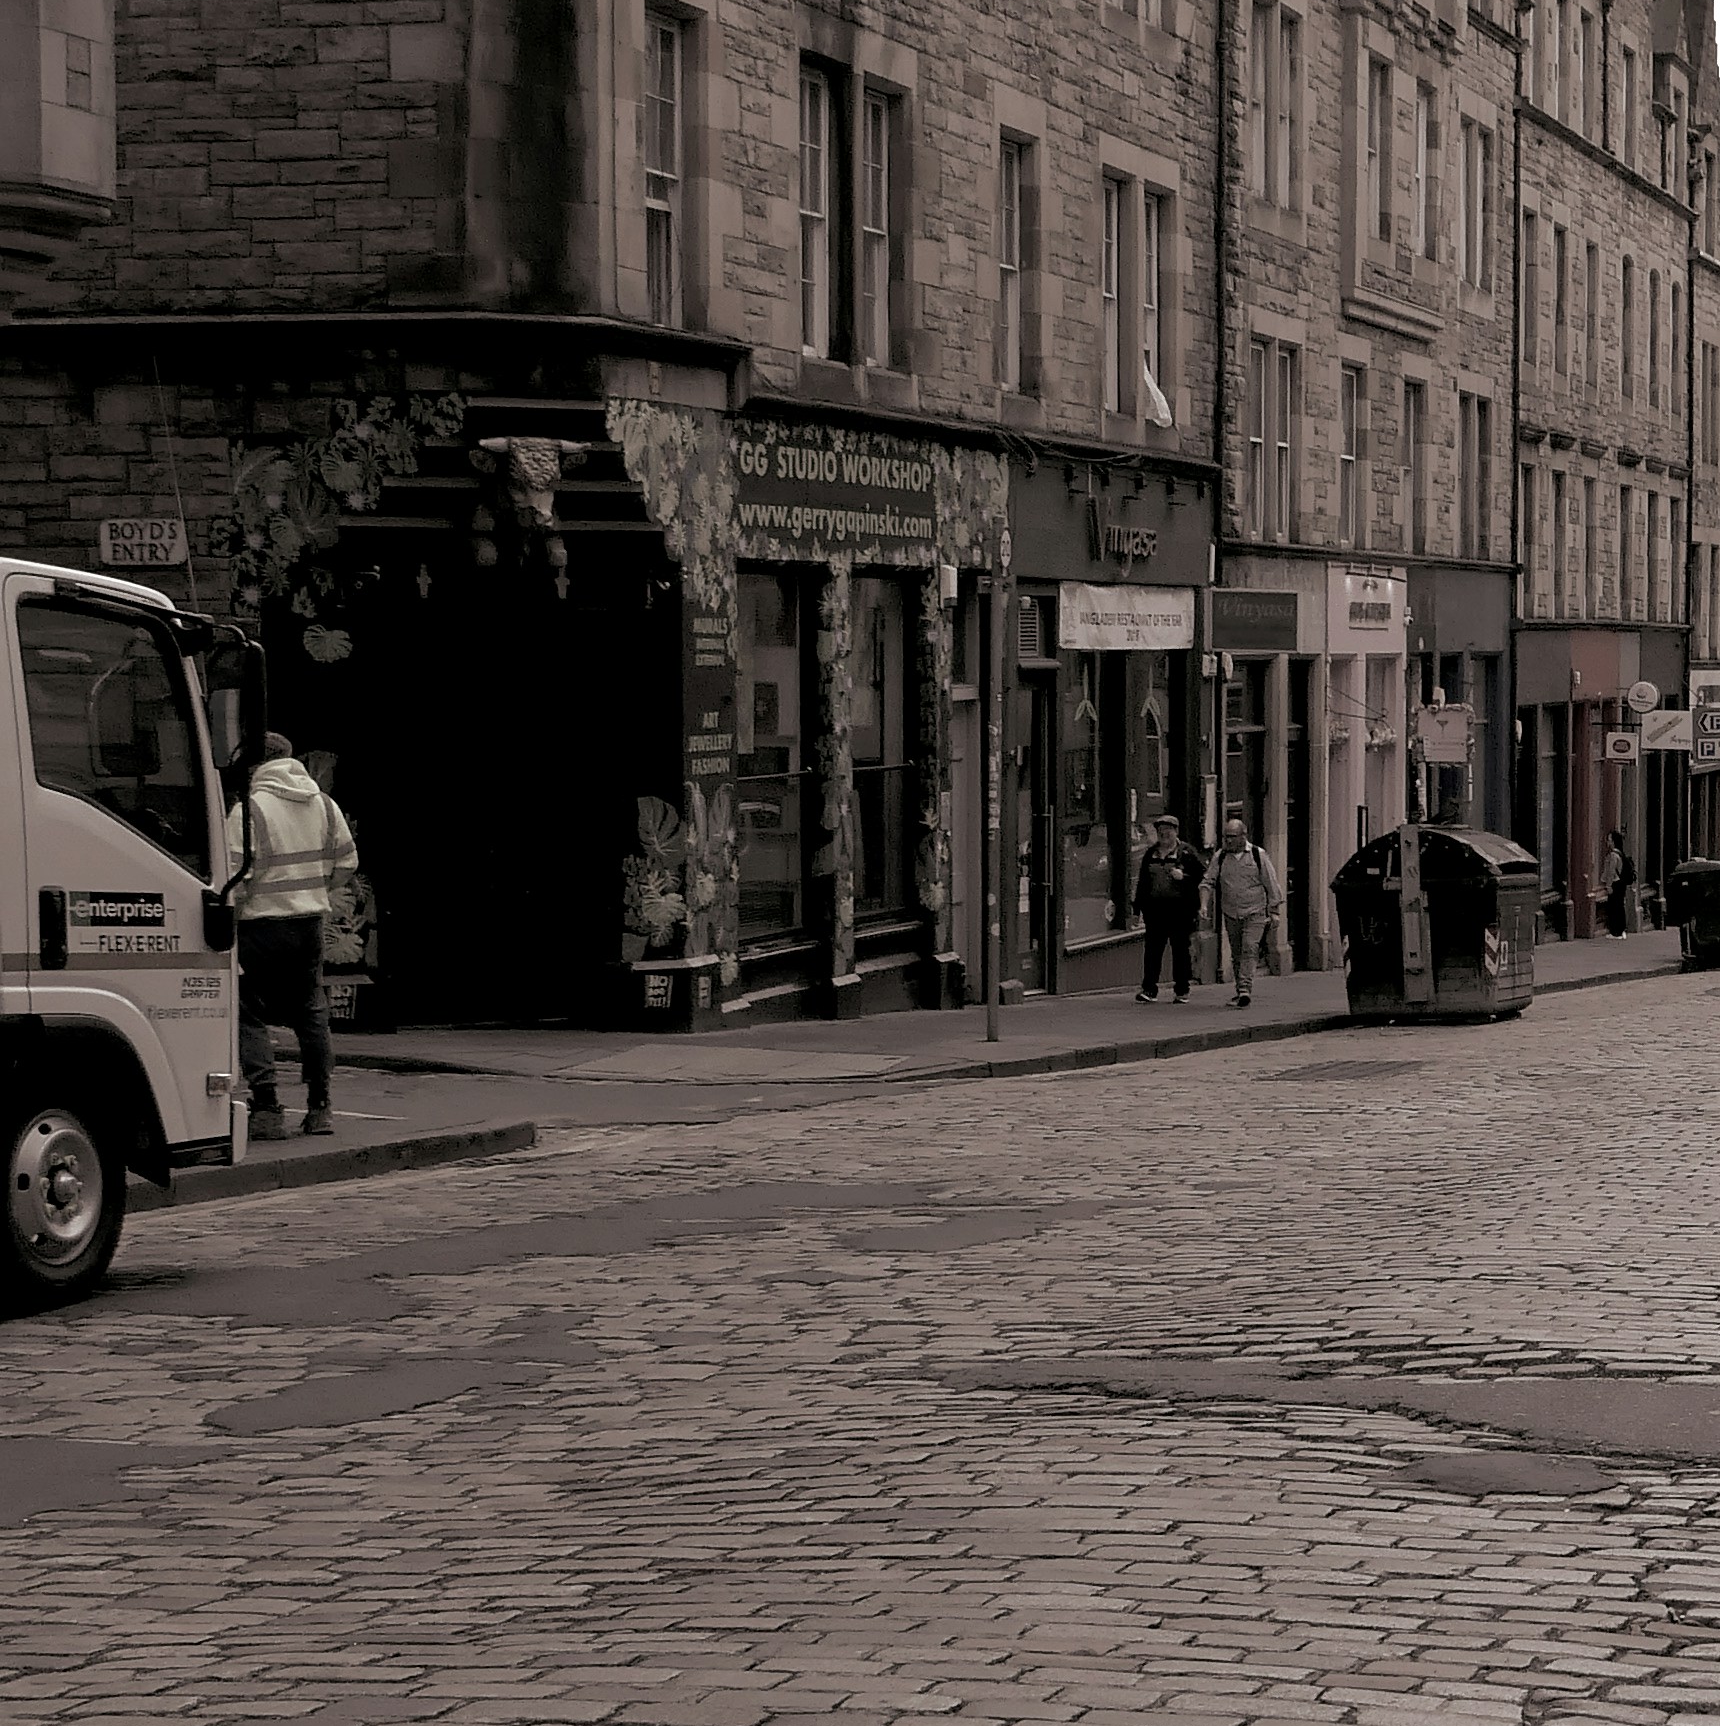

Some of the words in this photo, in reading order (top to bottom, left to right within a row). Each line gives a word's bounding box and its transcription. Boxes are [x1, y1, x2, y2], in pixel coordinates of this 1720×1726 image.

[739, 441, 769, 477] GG
[776, 445, 838, 483] STUDIO
[841, 452, 933, 493] WORKSHOP
[108, 520, 178, 541] BOYD'S
[738, 502, 933, 542] www.gerrygapinski.com
[112, 542, 176, 562] ENTRY
[702, 711, 719, 729] ART
[688, 733, 733, 753] JEWELLERY
[691, 757, 730, 776] FASHION
[75, 898, 163, 923] enterprise
